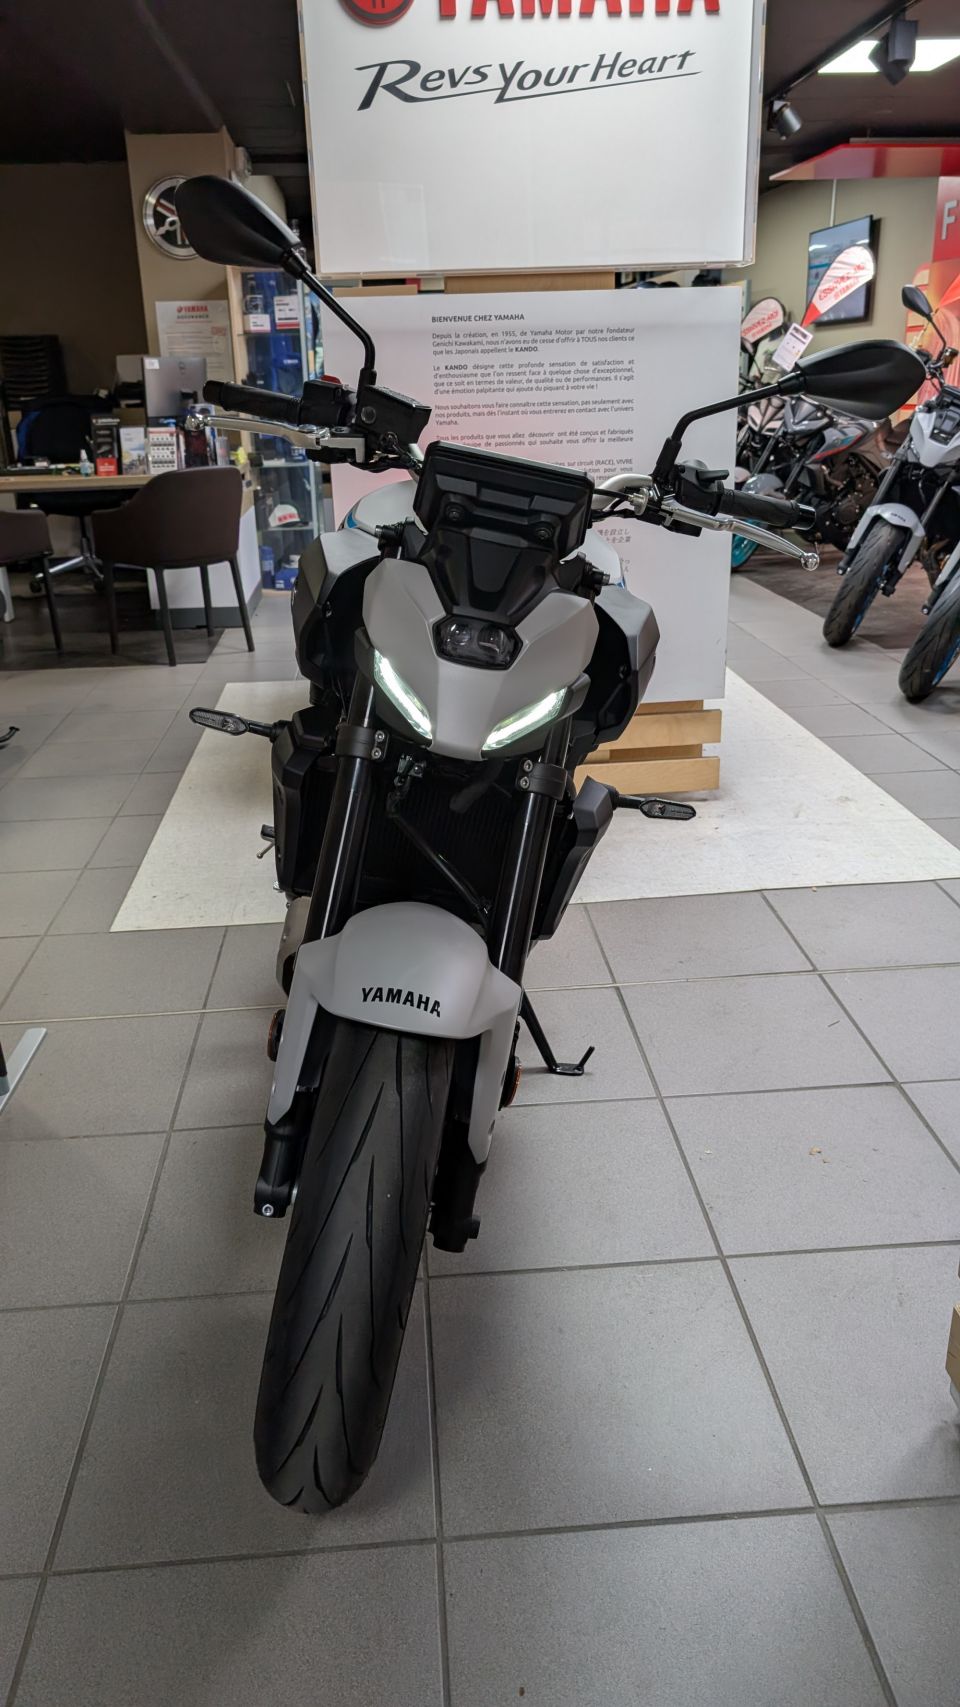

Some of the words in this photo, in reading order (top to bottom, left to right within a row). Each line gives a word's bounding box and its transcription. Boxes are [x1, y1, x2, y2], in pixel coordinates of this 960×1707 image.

[354, 59, 493, 111] Revs
[494, 61, 591, 104] Your
[590, 50, 697, 82] Heart
[432, 332, 452, 340] Depuis
[462, 331, 488, 339] création,
[455, 347, 479, 355] Japonais
[480, 346, 507, 355] appellent
[472, 362, 494, 371] désigne
[518, 361, 544, 369] profonde
[433, 371, 478, 379] d'enthousiasme
[548, 368, 571, 376] quelque
[591, 366, 634, 375] d'exceptionnel,
[505, 377, 523, 385] valeur,
[534, 376, 553, 385] qualité
[619, 374, 634, 382] s'agit
[475, 386, 504, 394] palpitante
[505, 385, 515, 393] qui
[516, 385, 533, 393] ajoute
[543, 384, 564, 392] piquant
[551, 399, 580, 407] sensation,
[446, 410, 470, 419] produits,
[460, 433, 483, 441] produits
[607, 427, 633, 436] fabriqués
[494, 439, 525, 448] passionnés
[362, 987, 441, 1018] YAMAHA
